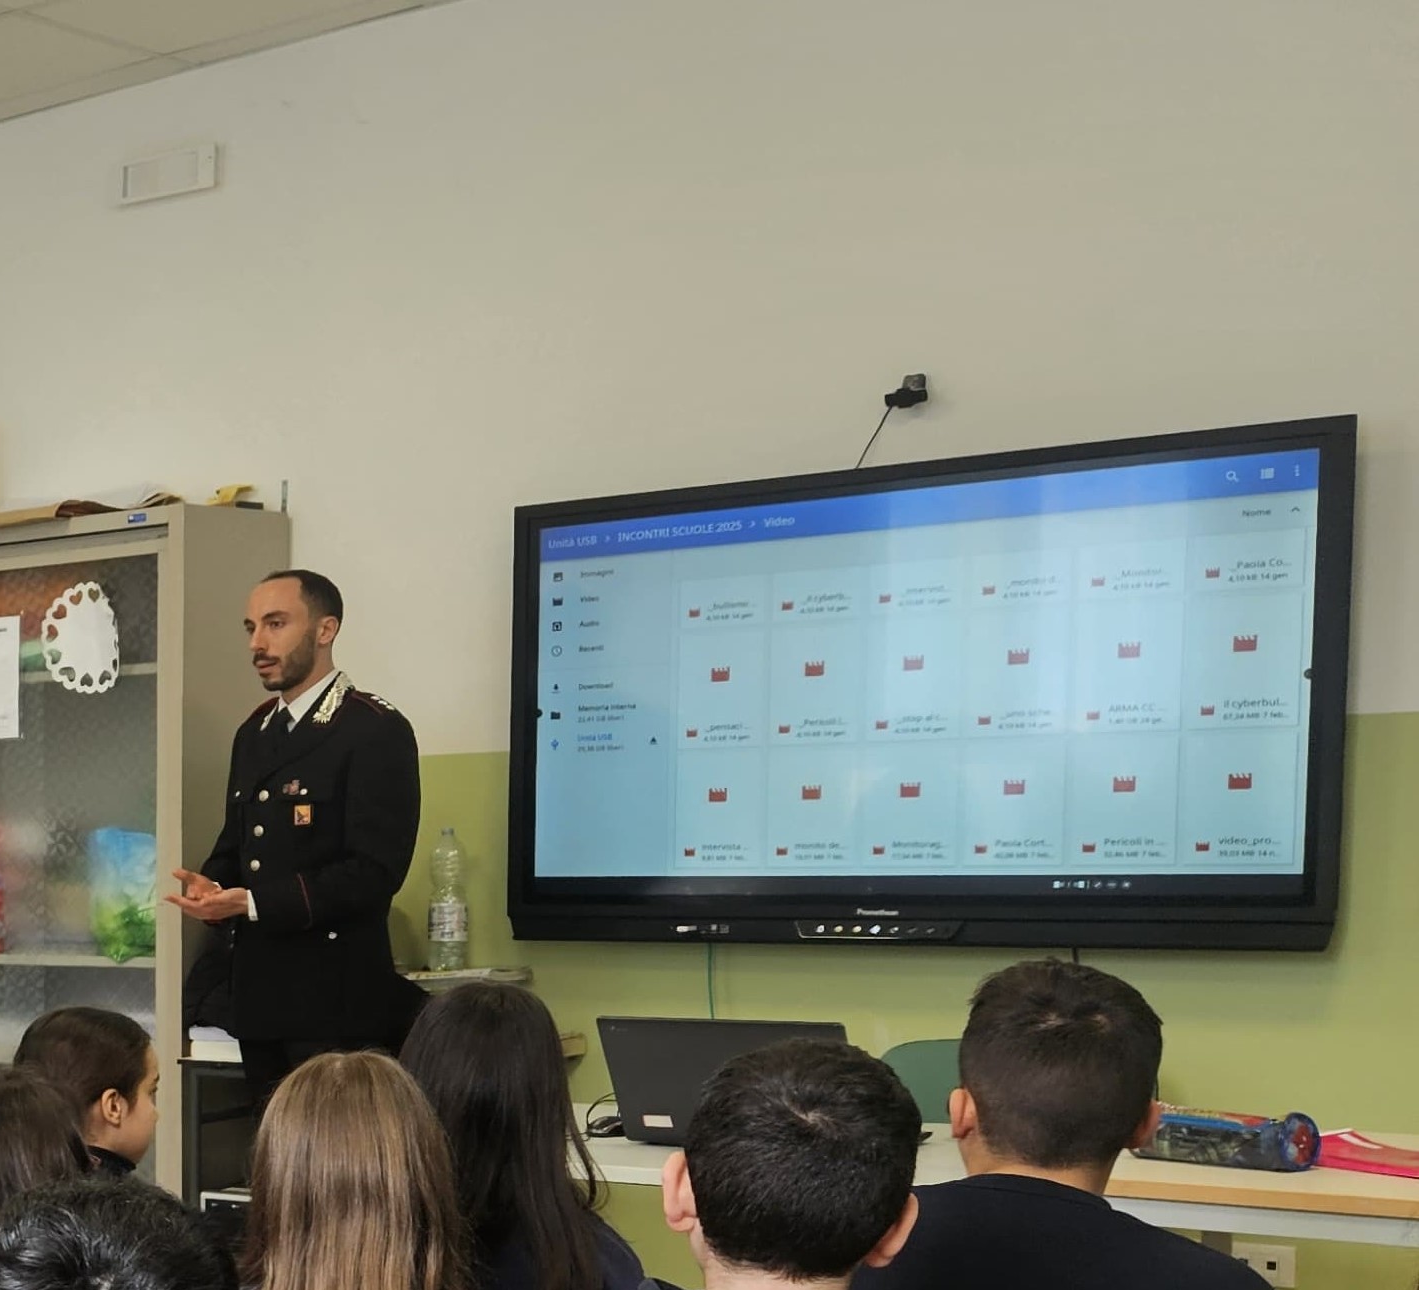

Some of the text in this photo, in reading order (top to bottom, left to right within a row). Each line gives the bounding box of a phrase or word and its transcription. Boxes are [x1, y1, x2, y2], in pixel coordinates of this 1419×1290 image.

[1242, 508, 1271, 517] Nome
[548, 516, 795, 549] Unità USB INCONTRI SCUOLE 2025 Video
